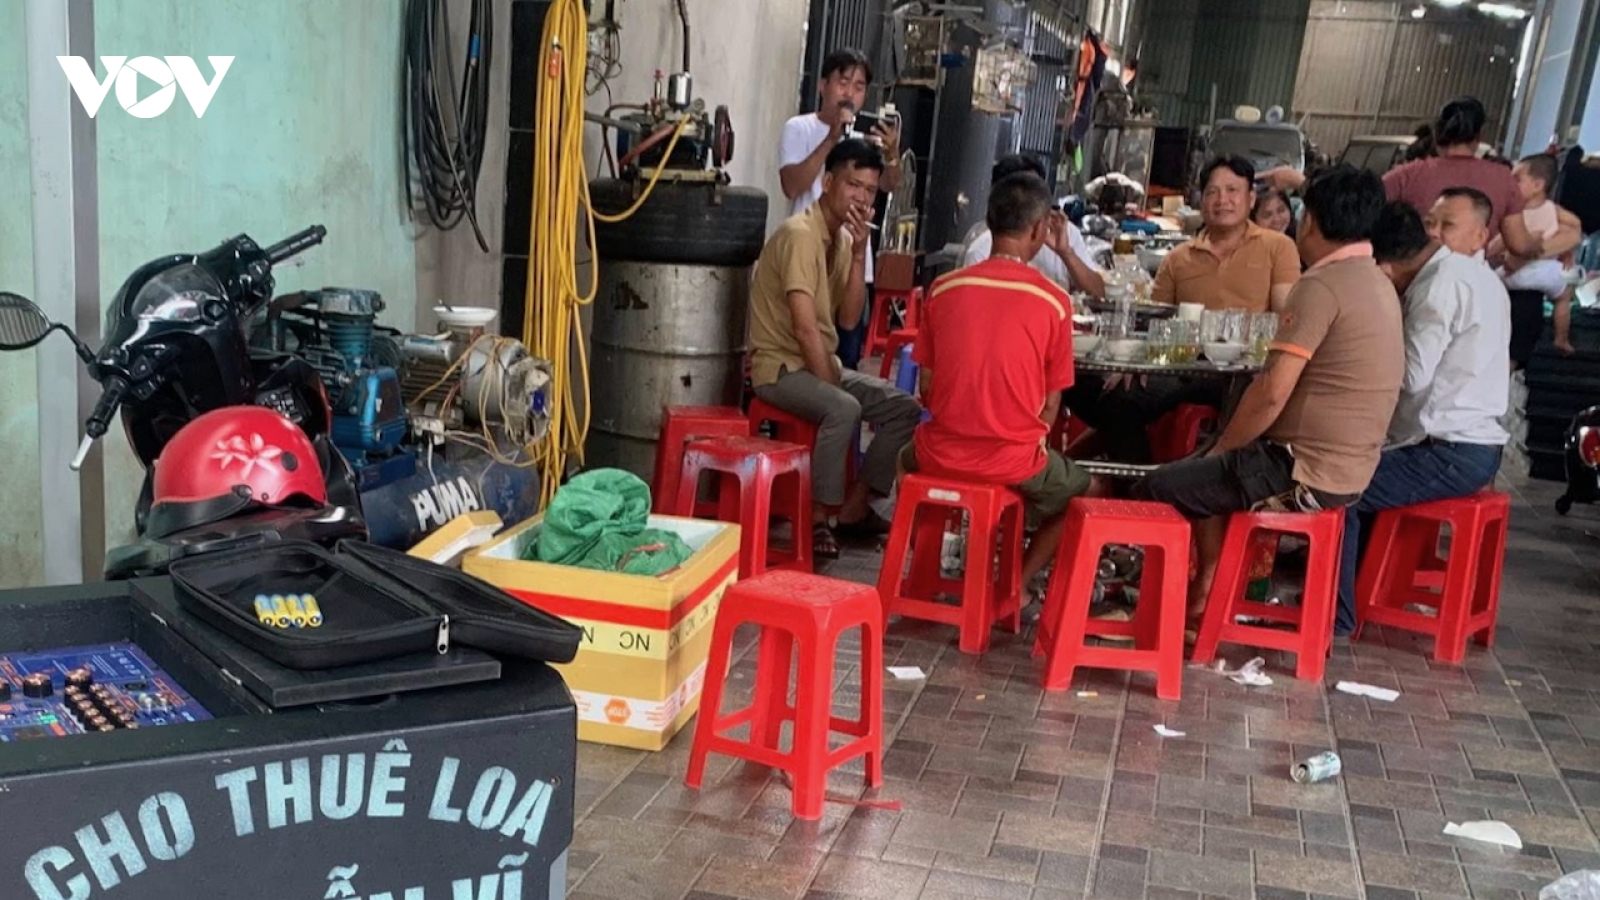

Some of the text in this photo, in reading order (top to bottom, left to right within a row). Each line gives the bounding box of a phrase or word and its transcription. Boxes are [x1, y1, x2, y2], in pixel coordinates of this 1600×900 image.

[410, 476, 479, 532] PUMA
[619, 631, 651, 651] NC
[24, 738, 553, 900] CHO THUÊ LOA
